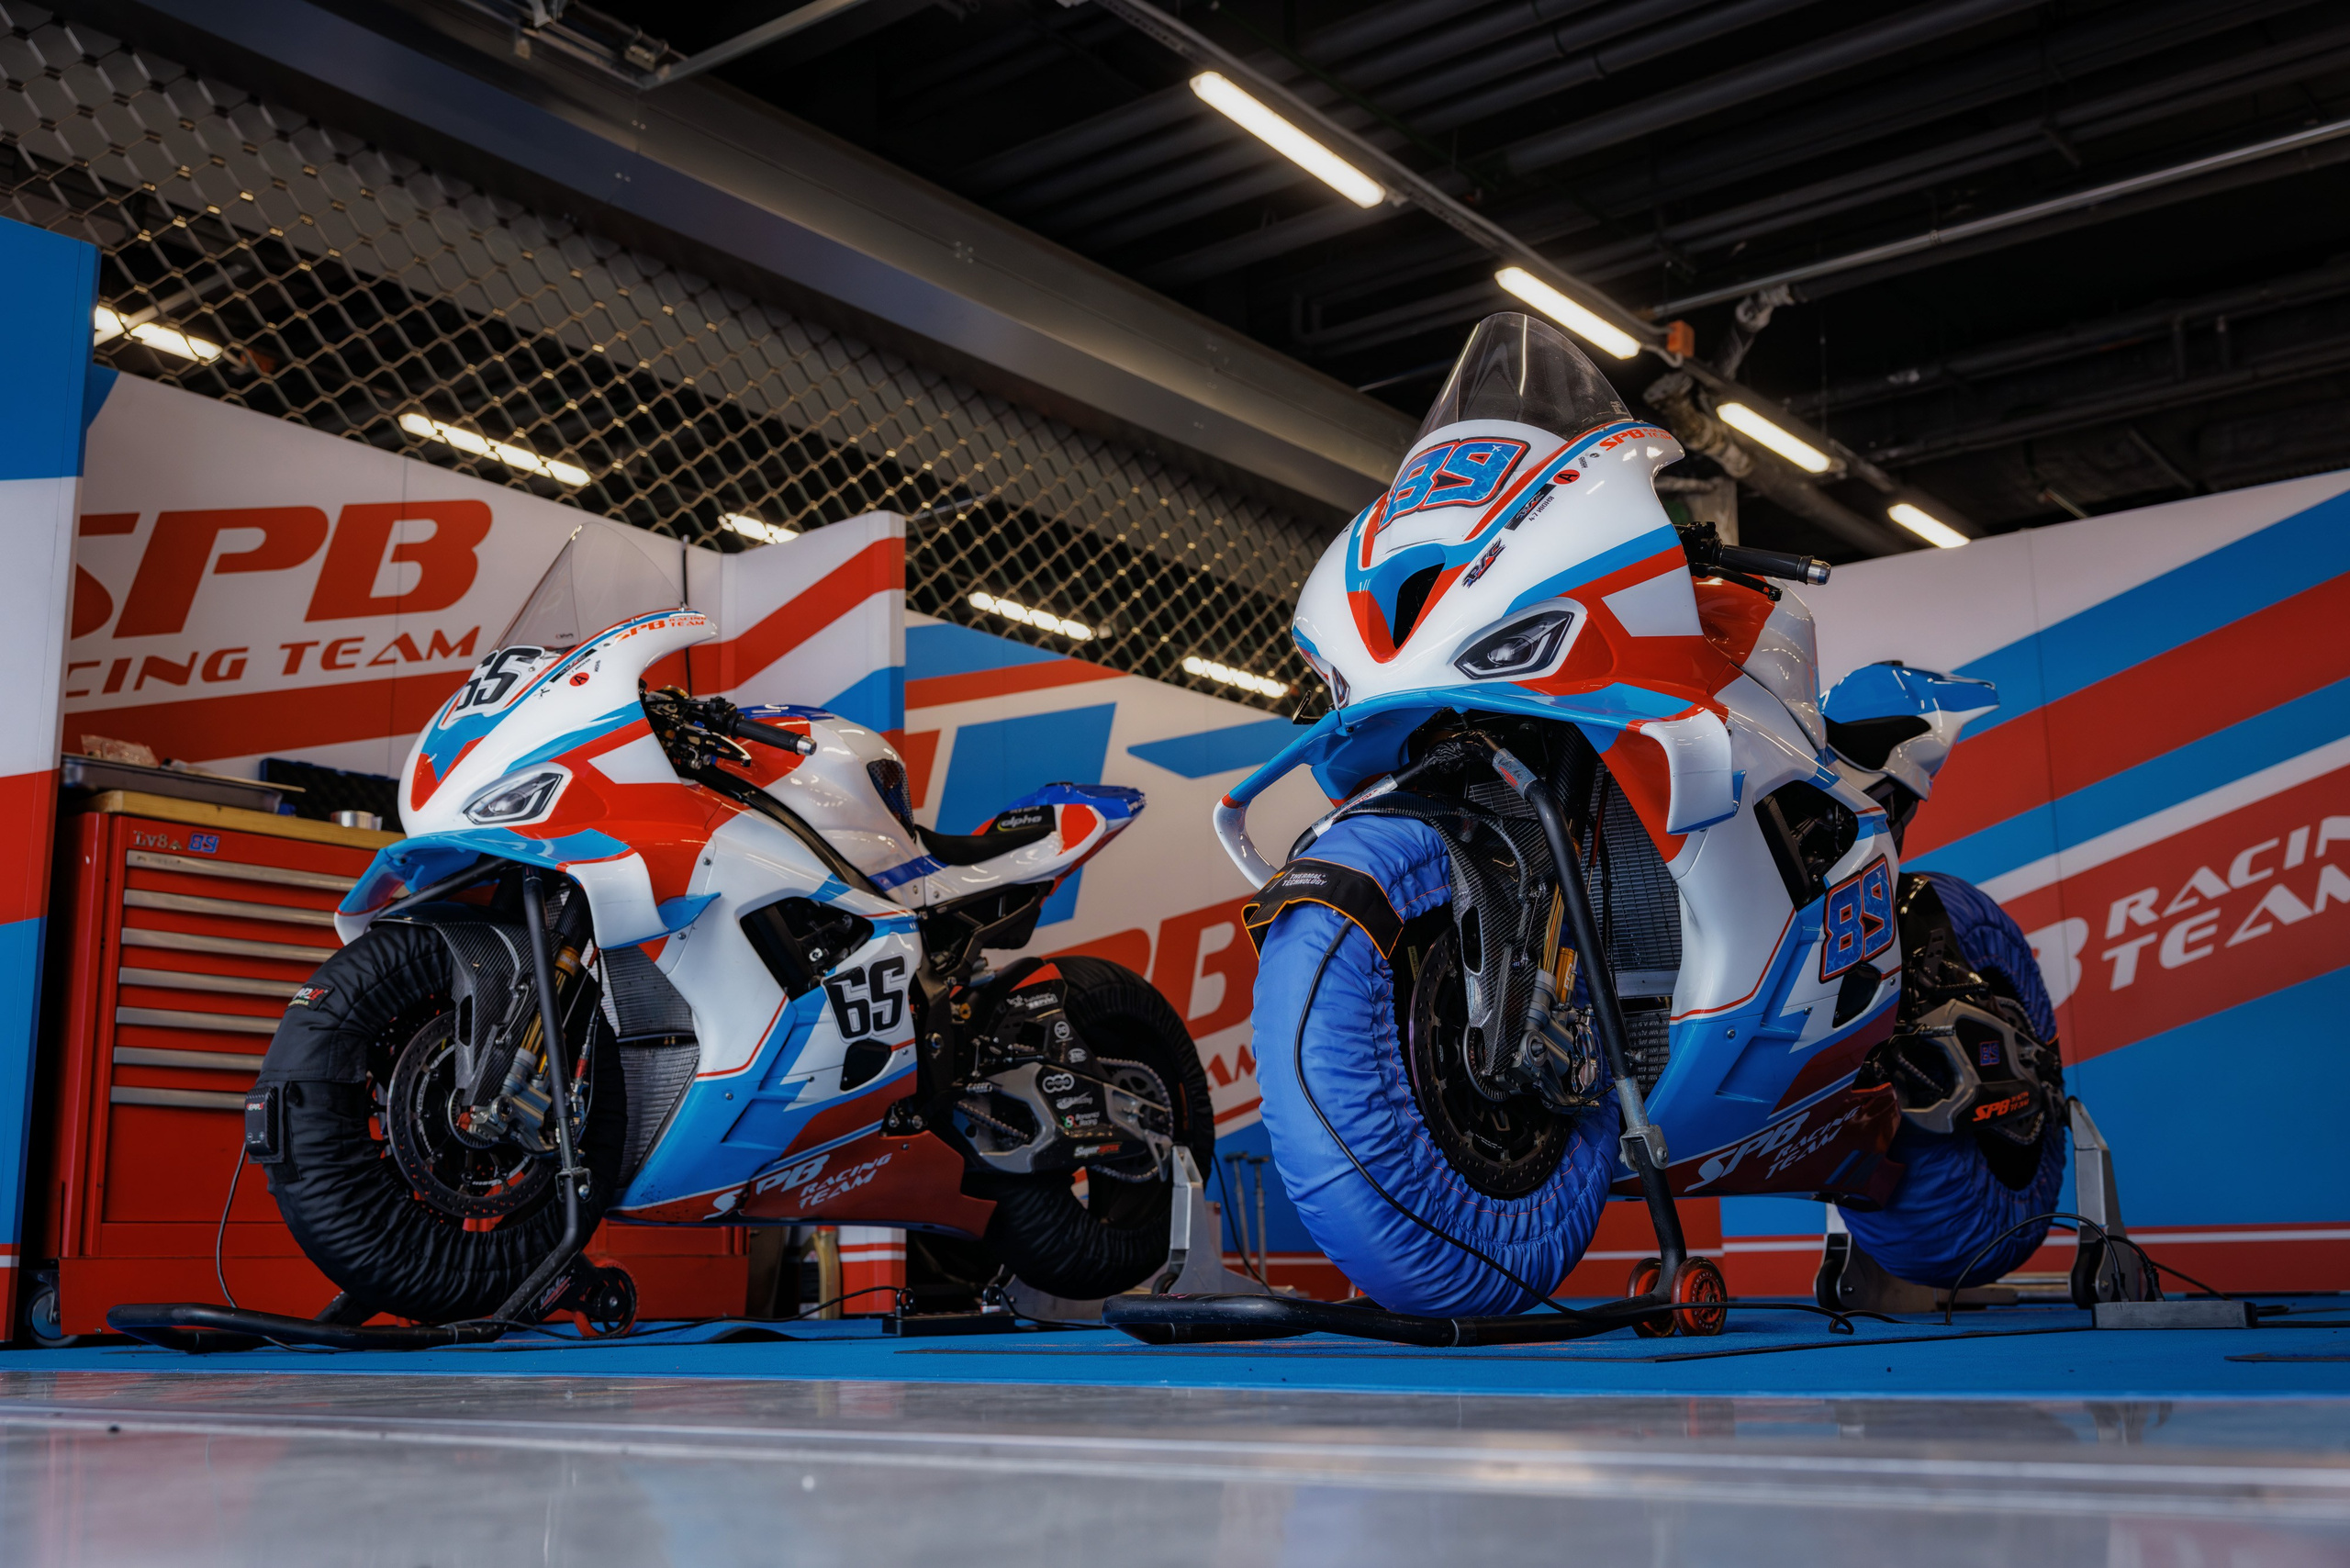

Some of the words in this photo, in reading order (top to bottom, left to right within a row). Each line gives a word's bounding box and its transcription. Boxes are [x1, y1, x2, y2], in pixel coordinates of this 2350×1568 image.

[1599, 429, 1645, 451] SPB
[1377, 437, 1530, 534] 89
[279, 625, 481, 676] TEAM
[1001, 815, 1042, 828] alpha
[1282, 879, 1327, 887] TECHNOLOGY
[1819, 854, 1896, 983] 89
[822, 955, 905, 1039] 65
[1973, 1099, 2010, 1122] SPB
[1684, 1111, 1810, 1193] SPB
[1774, 1105, 1860, 1162] RACING
[1765, 1126, 1842, 1181] TEAM
[703, 1154, 830, 1220] SPB
[800, 1153, 892, 1197] RACING
[799, 1170, 877, 1209] TEAM
